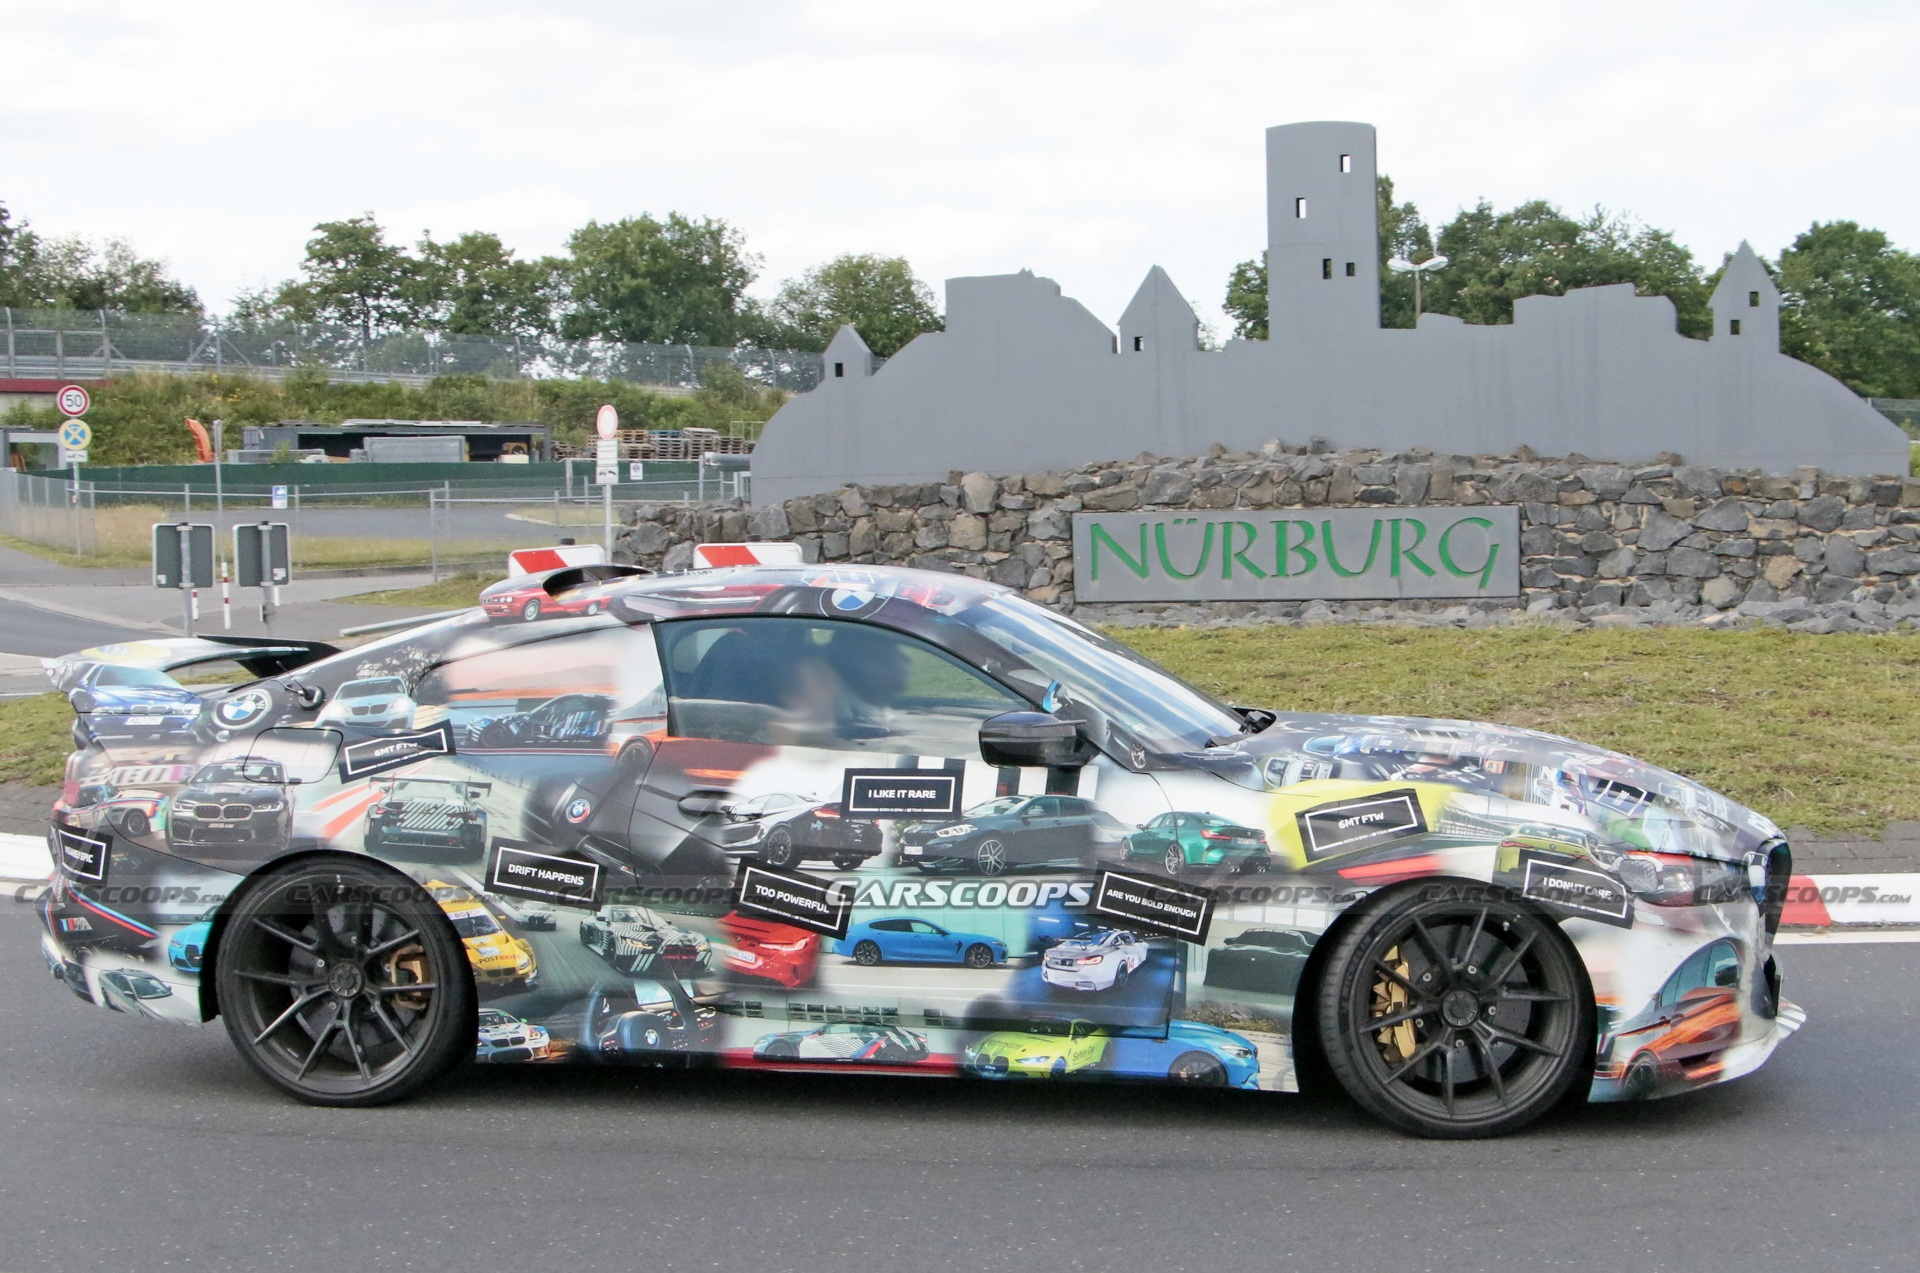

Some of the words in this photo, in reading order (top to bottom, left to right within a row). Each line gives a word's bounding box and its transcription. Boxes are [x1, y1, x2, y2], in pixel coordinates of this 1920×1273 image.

[66, 394, 82, 407] 50
[1090, 517, 1500, 590] NÜRBURG
[868, 789, 872, 798] I
[873, 789, 896, 798] LIKE
[897, 789, 908, 798] IT
[908, 789, 937, 799] RARE
[1338, 816, 1361, 829] 6MT
[1361, 812, 1384, 824] FTW
[508, 863, 538, 878] DRIFT
[538, 869, 585, 886] HAPPENS
[755, 884, 776, 898] TOO
[776, 890, 830, 913] POWERFUL
[1543, 877, 1547, 887] I
[1548, 878, 1585, 893] DONUT
[1585, 885, 1612, 900] CARE
[1106, 889, 1124, 900] ARE
[1125, 893, 1141, 904] YOU
[1141, 898, 1164, 910] BOLD
[1164, 904, 1197, 919] ENOUGH
